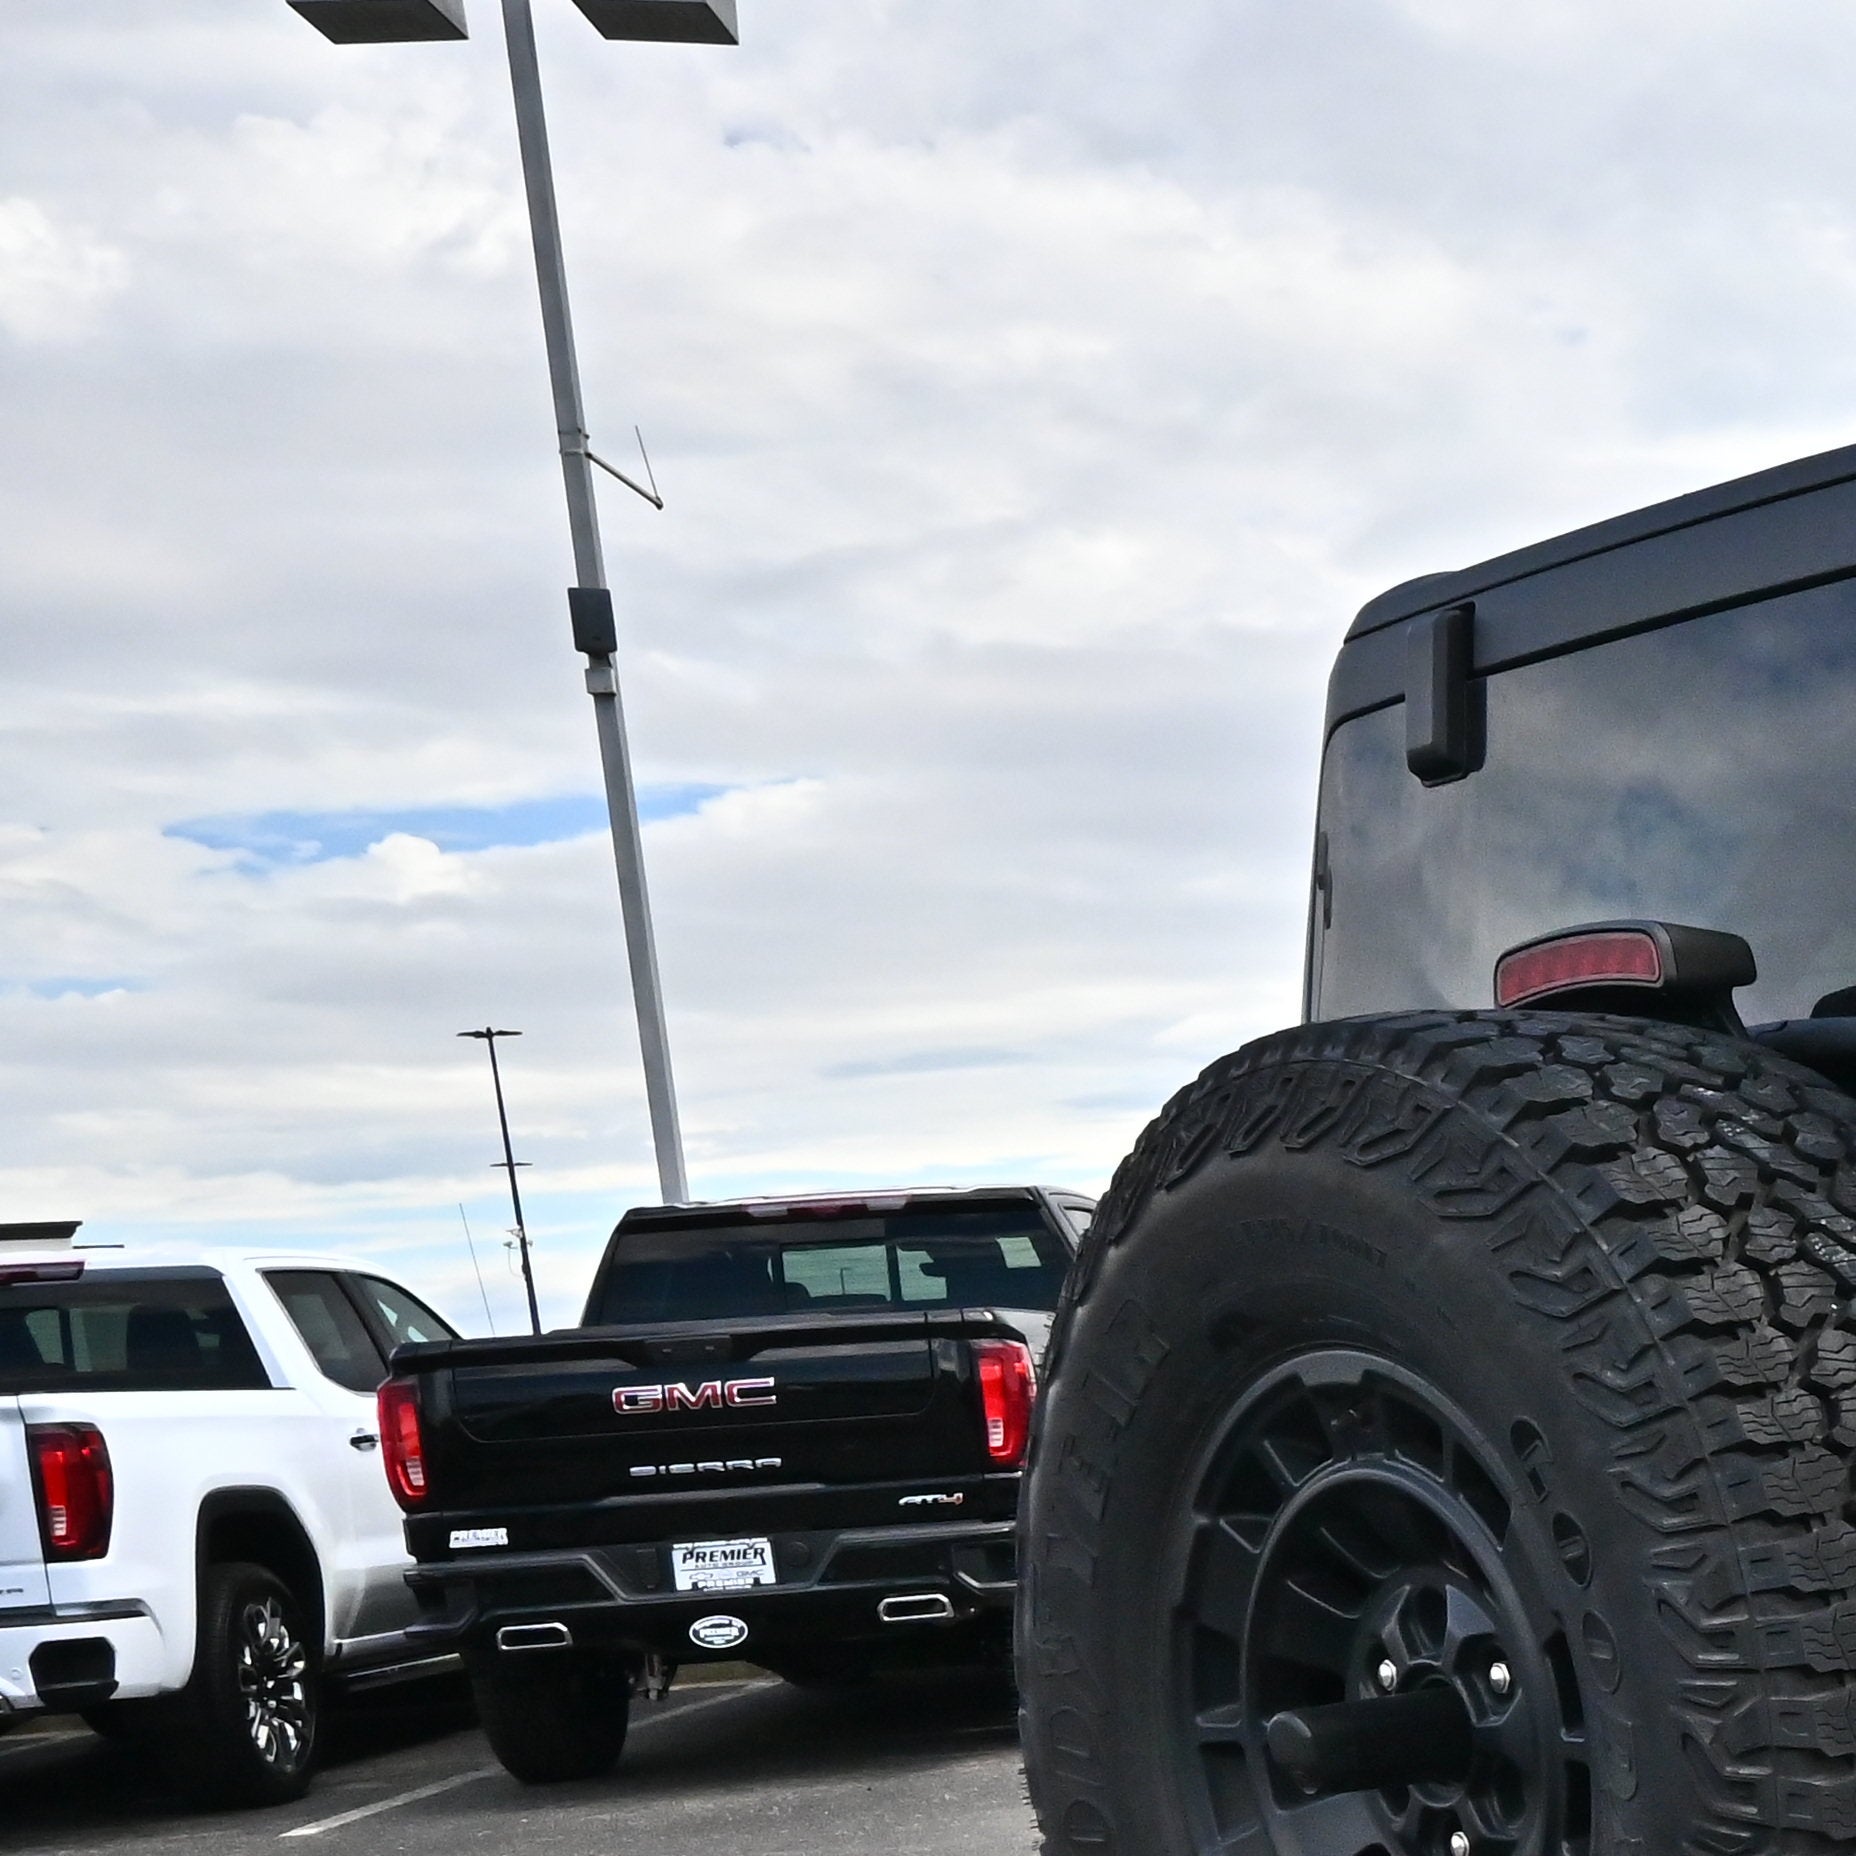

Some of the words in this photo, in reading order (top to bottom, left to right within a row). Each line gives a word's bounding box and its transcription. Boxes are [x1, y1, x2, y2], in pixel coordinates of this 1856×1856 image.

[612, 1376, 777, 1415] GMC
[629, 1457, 782, 1477] SIERRA
[682, 1548, 767, 1565] PREMIER
[736, 1569, 765, 1577] GMC
